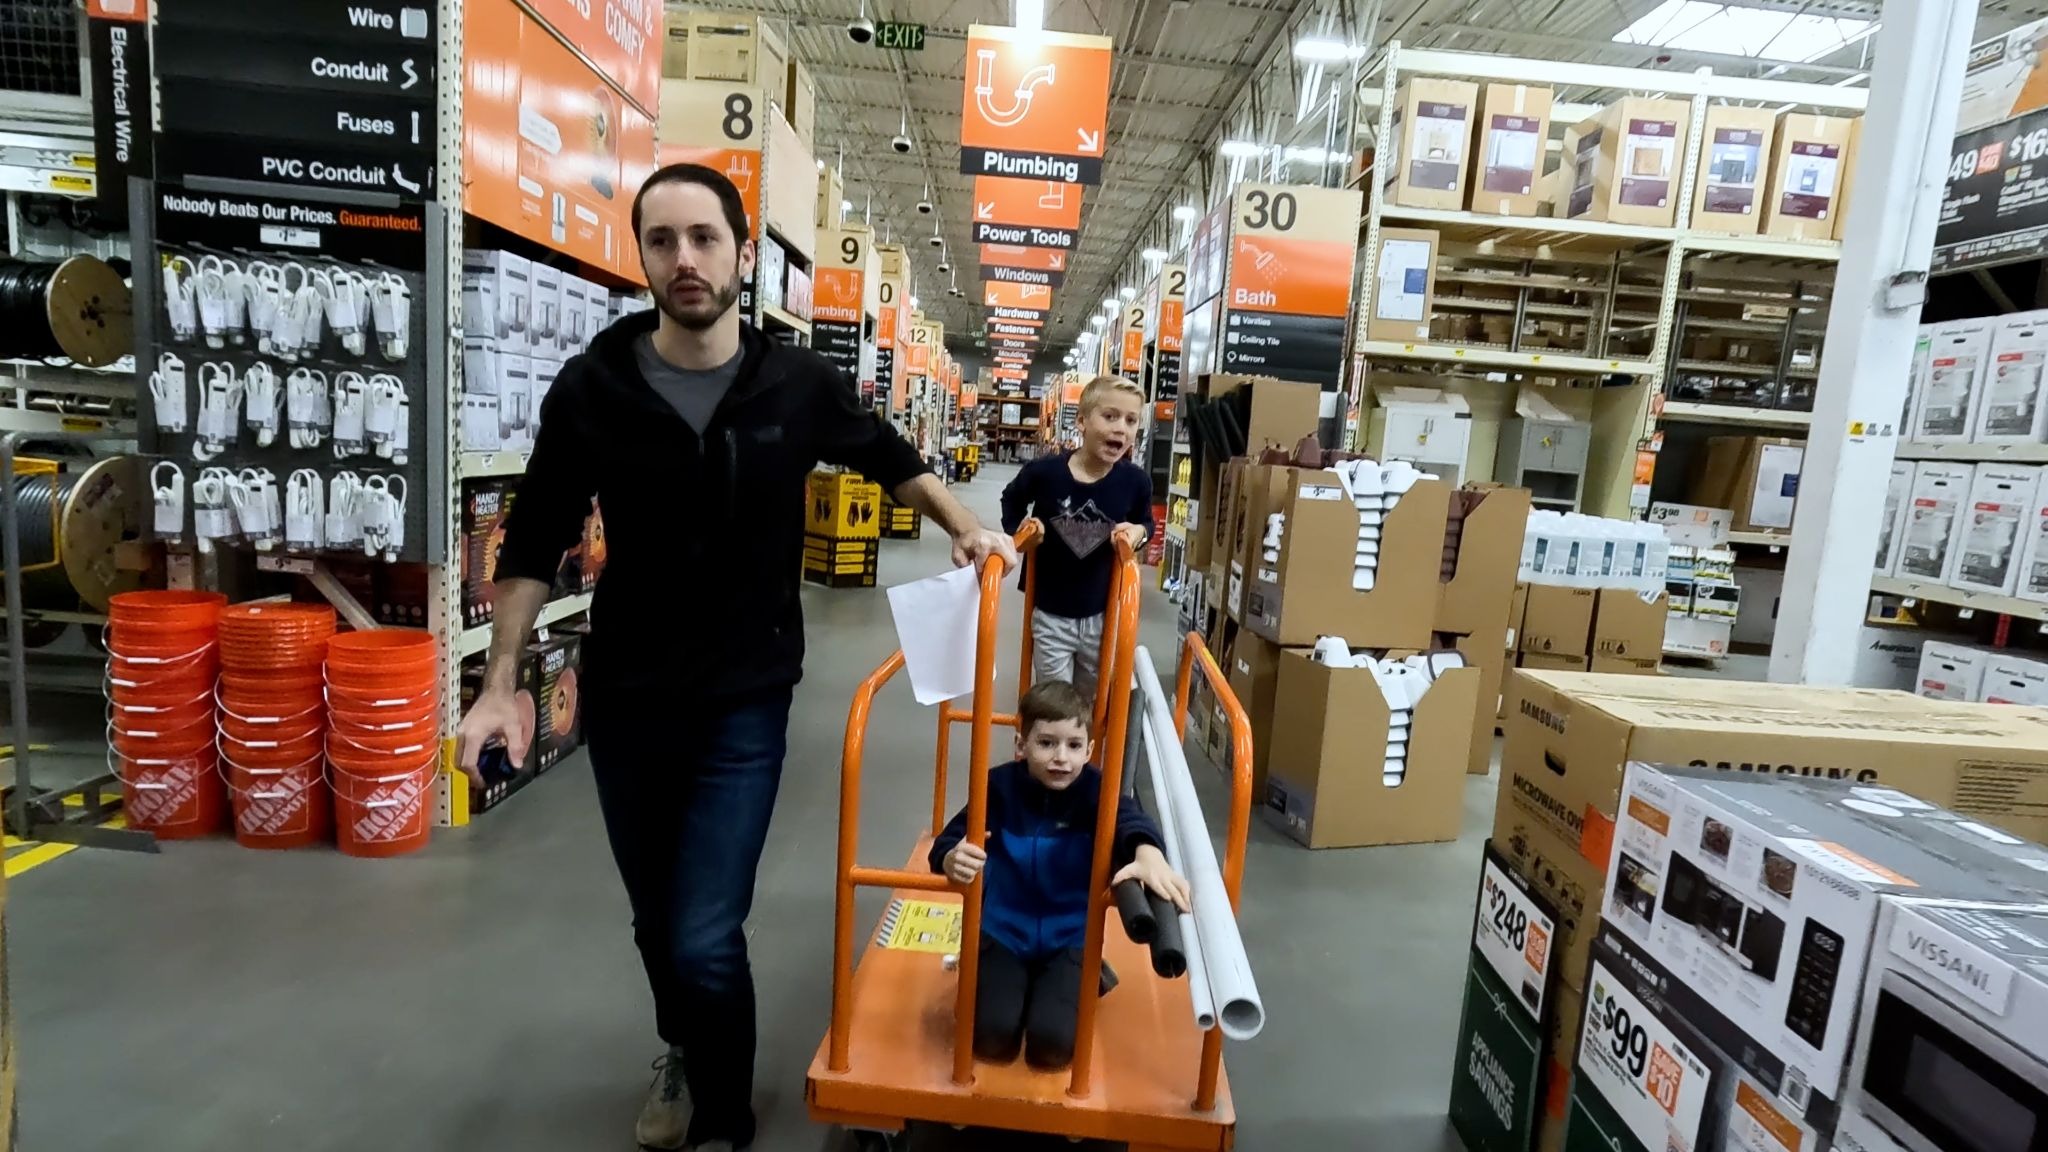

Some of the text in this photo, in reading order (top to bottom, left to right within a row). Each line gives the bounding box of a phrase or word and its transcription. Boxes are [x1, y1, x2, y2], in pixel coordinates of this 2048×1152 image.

[347, 8, 394, 29] Wire
[605, 1, 645, 64] COMFY
[883, 24, 917, 48] EXIT
[311, 58, 389, 82] Conduit
[110, 27, 130, 163] Electrical Wire
[337, 112, 394, 135] Fuses
[722, 93, 753, 140] 8
[2009, 127, 2048, 159] $16
[263, 157, 386, 186] PVC Conduit
[984, 151, 1079, 182] Plumbing
[164, 196, 421, 232] Nobody Beats Our Prices. Guaranteed.
[1243, 190, 1297, 231] 30
[840, 237, 859, 264] 9
[979, 225, 1071, 247] Power Tools
[994, 267, 1049, 284] Windows
[1169, 271, 1185, 295] 2
[994, 306, 1040, 320] Hardware
[1235, 288, 1277, 307] Bath
[995, 323, 1035, 335] Fasteners
[1130, 308, 1144, 328] 2
[1243, 316, 1271, 327] Vanities
[910, 328, 926, 344] 12
[1003, 339, 1026, 349] Doors
[1240, 335, 1280, 347] Ceiling Tile
[1238, 354, 1265, 364] Mirrors
[1066, 373, 1079, 384] 24
[1520, 698, 1566, 735] SAMSUNG
[128, 759, 198, 823] HOME
[154, 777, 198, 826] DEPOT
[238, 767, 309, 834] HOME
[1513, 772, 1566, 820] MICROWAVE
[262, 787, 307, 836] DEPOT
[353, 774, 422, 841] HOME
[381, 788, 421, 841] DEPOT
[1490, 882, 1527, 952] $248
[1603, 995, 1648, 1078] $99
[1472, 1030, 1515, 1104] APPLIANCE
[1654, 1047, 1680, 1083] SAVE
[1469, 1051, 1513, 1132] SAVINGS
[1651, 1064, 1674, 1109] $10
